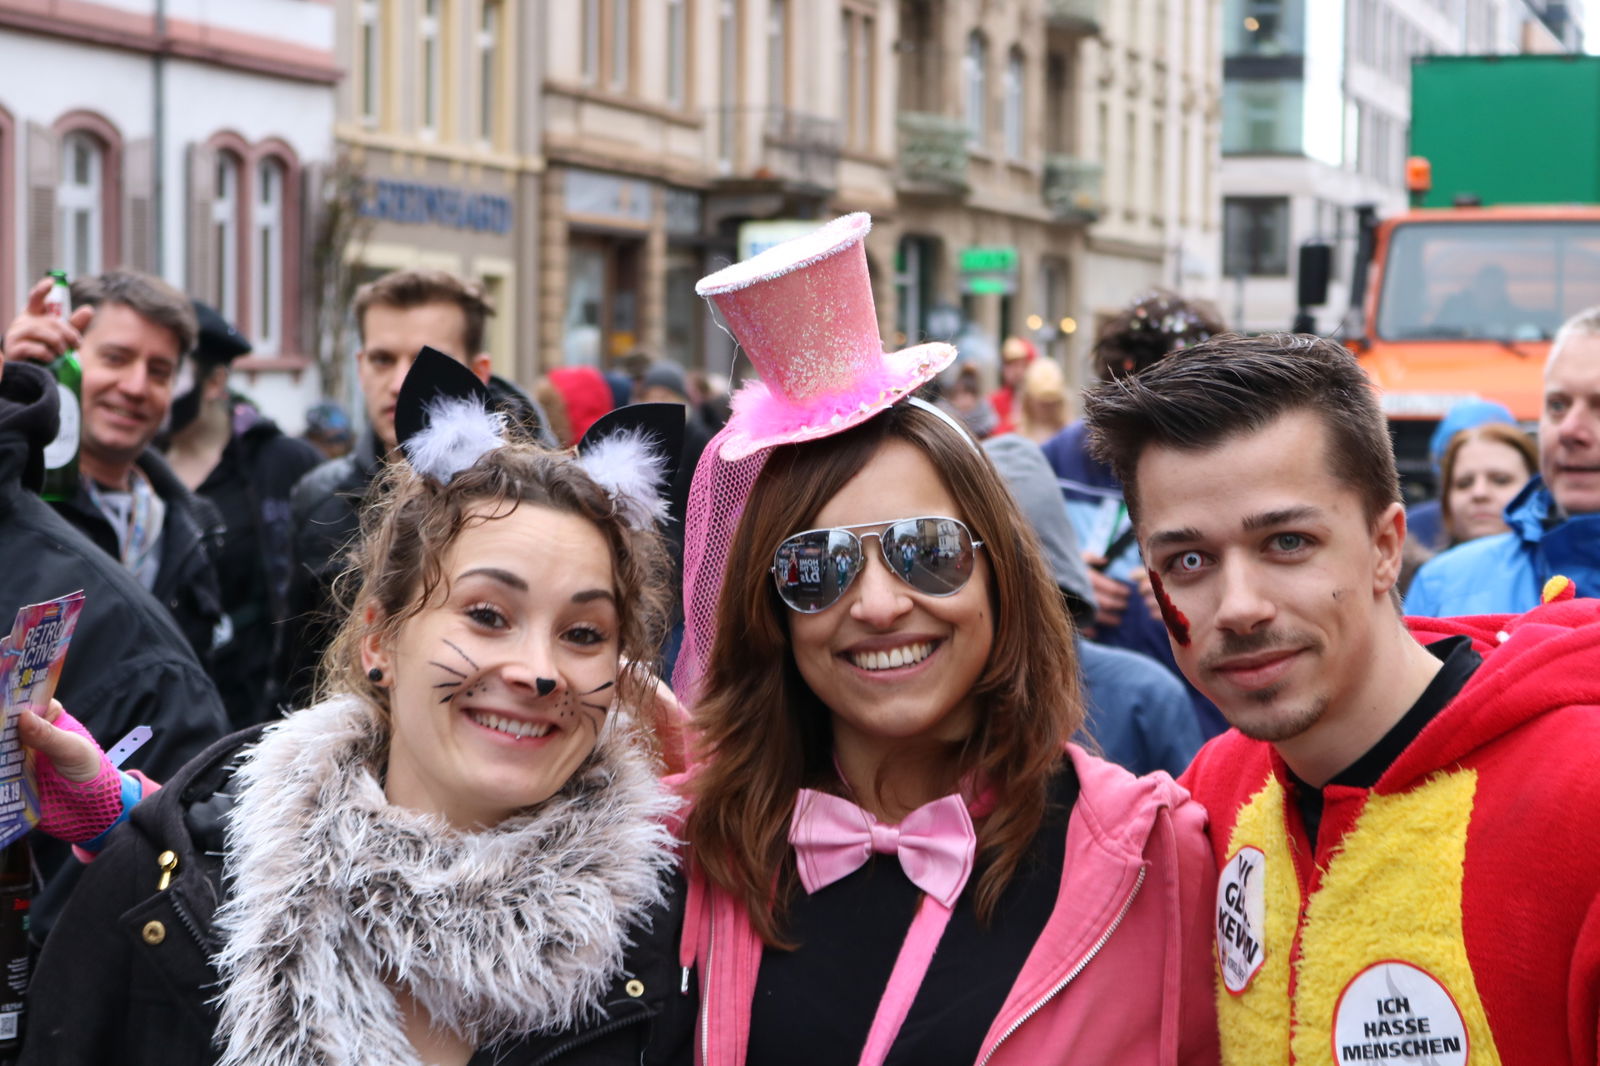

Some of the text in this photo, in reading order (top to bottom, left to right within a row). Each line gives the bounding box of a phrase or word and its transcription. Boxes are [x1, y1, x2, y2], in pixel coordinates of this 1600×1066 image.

[24, 619, 65, 648] RETRO
[16, 643, 57, 668] ACTIVE
[1377, 997, 1410, 1016] ICH
[1363, 1017, 1431, 1038] HASSE
[1342, 1036, 1461, 1061] MENSCHEN
